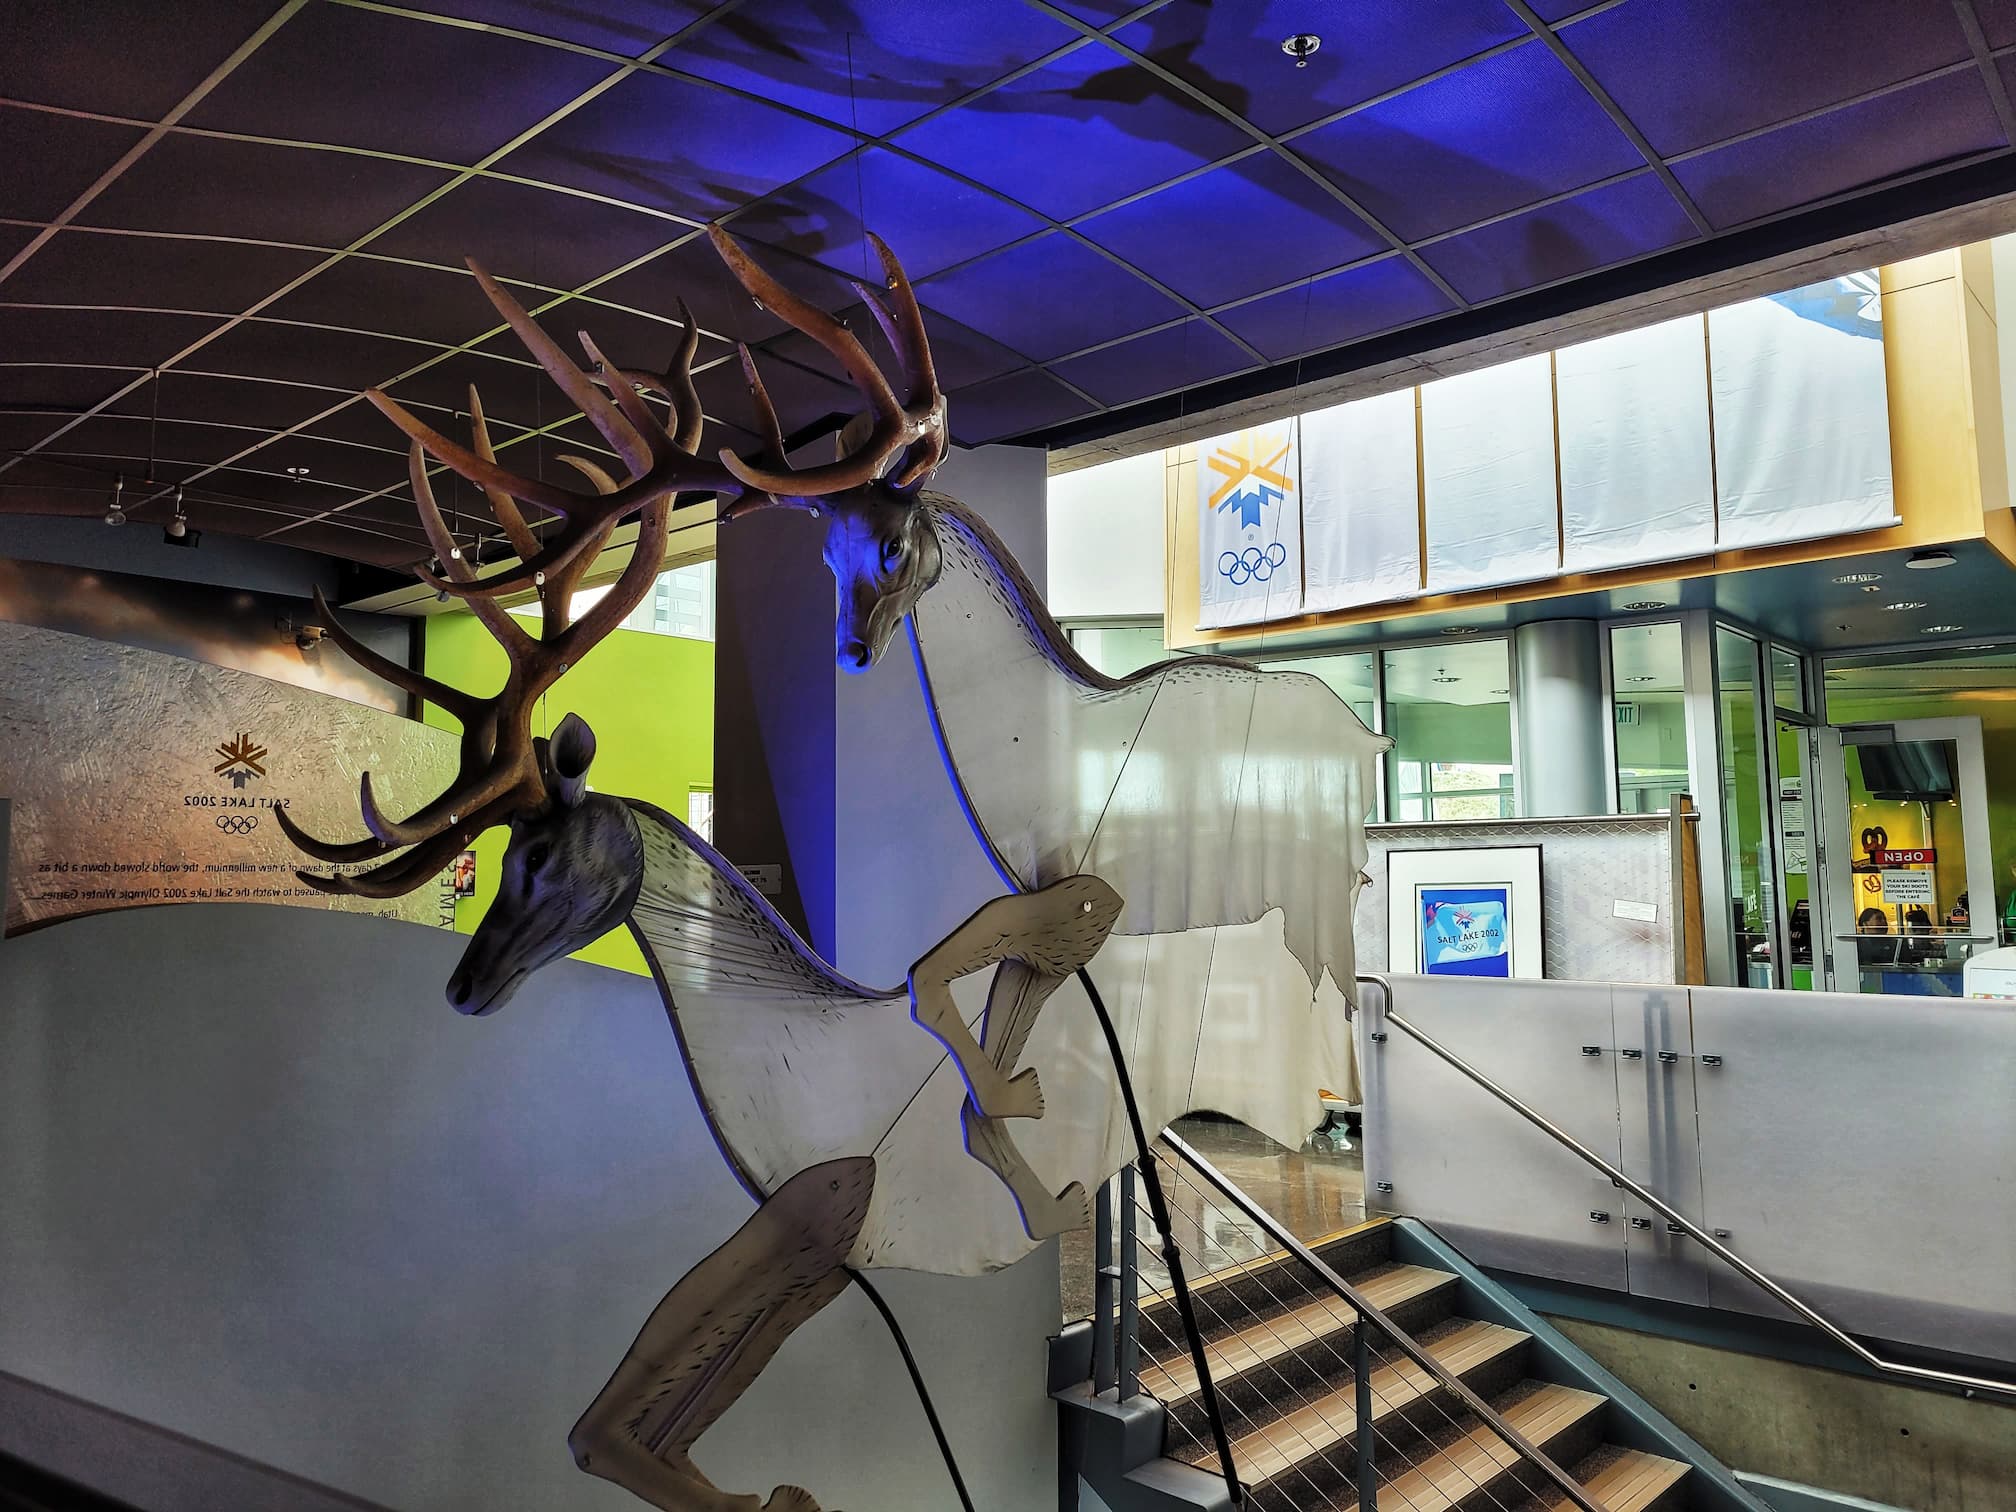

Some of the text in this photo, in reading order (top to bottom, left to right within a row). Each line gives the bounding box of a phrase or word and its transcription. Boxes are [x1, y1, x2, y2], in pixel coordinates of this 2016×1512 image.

[1884, 852, 1924, 862] OPEN
[1437, 928, 1499, 944] SALT LAKE 2002
